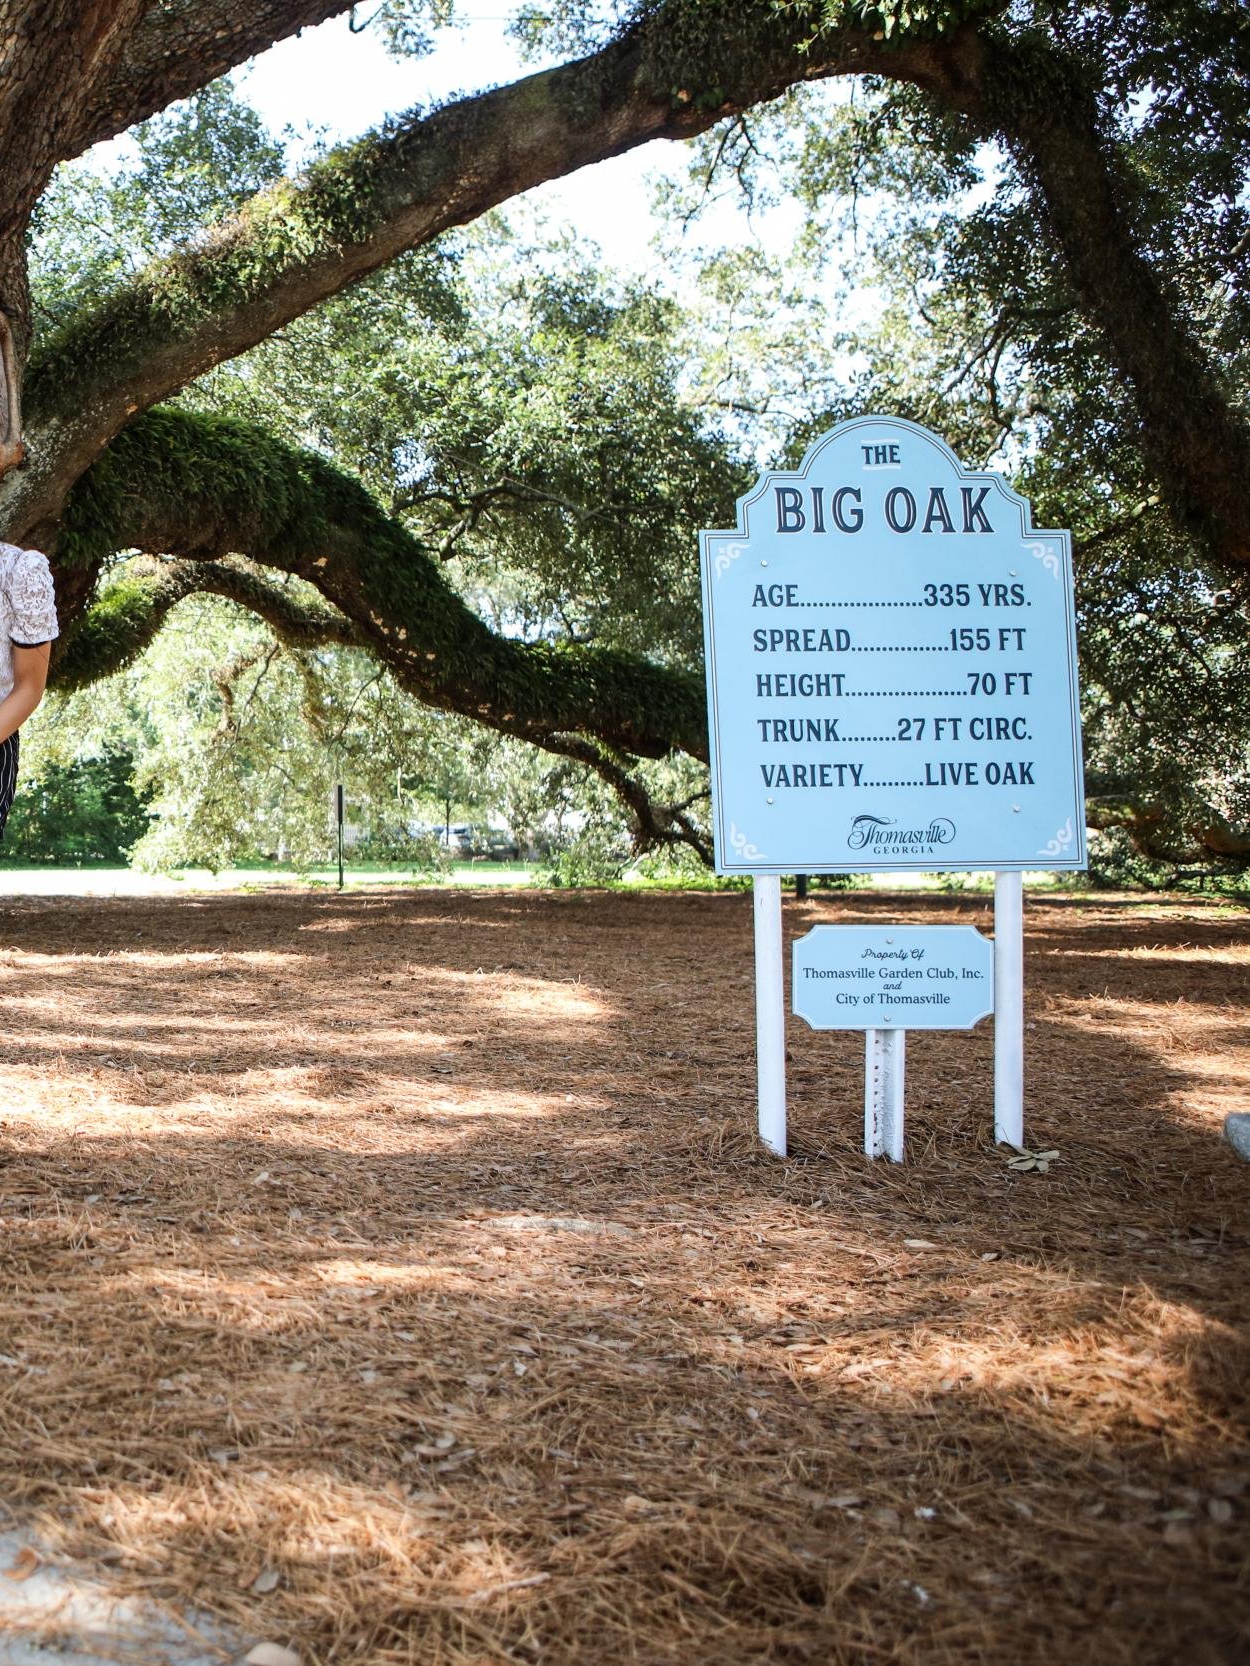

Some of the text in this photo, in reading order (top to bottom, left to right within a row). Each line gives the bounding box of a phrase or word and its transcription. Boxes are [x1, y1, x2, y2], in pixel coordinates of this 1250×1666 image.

[861, 444, 901, 465] THE
[773, 486, 995, 534] BIG OAK
[977, 583, 1032, 607] YRS.
[998, 627, 1027, 651] FT
[1004, 672, 1033, 696] FT
[934, 717, 962, 741] FT
[969, 716, 1033, 741] CIRC.
[985, 762, 1035, 786] OAK
[847, 814, 956, 851] Thomasville
[873, 844, 935, 855] GEORGIA
[861, 948, 925, 961] Property Of
[802, 967, 984, 981] Thomasville Garden Club, Inc.
[882, 981, 903, 990] and
[836, 993, 951, 1007] City of Thomasville
